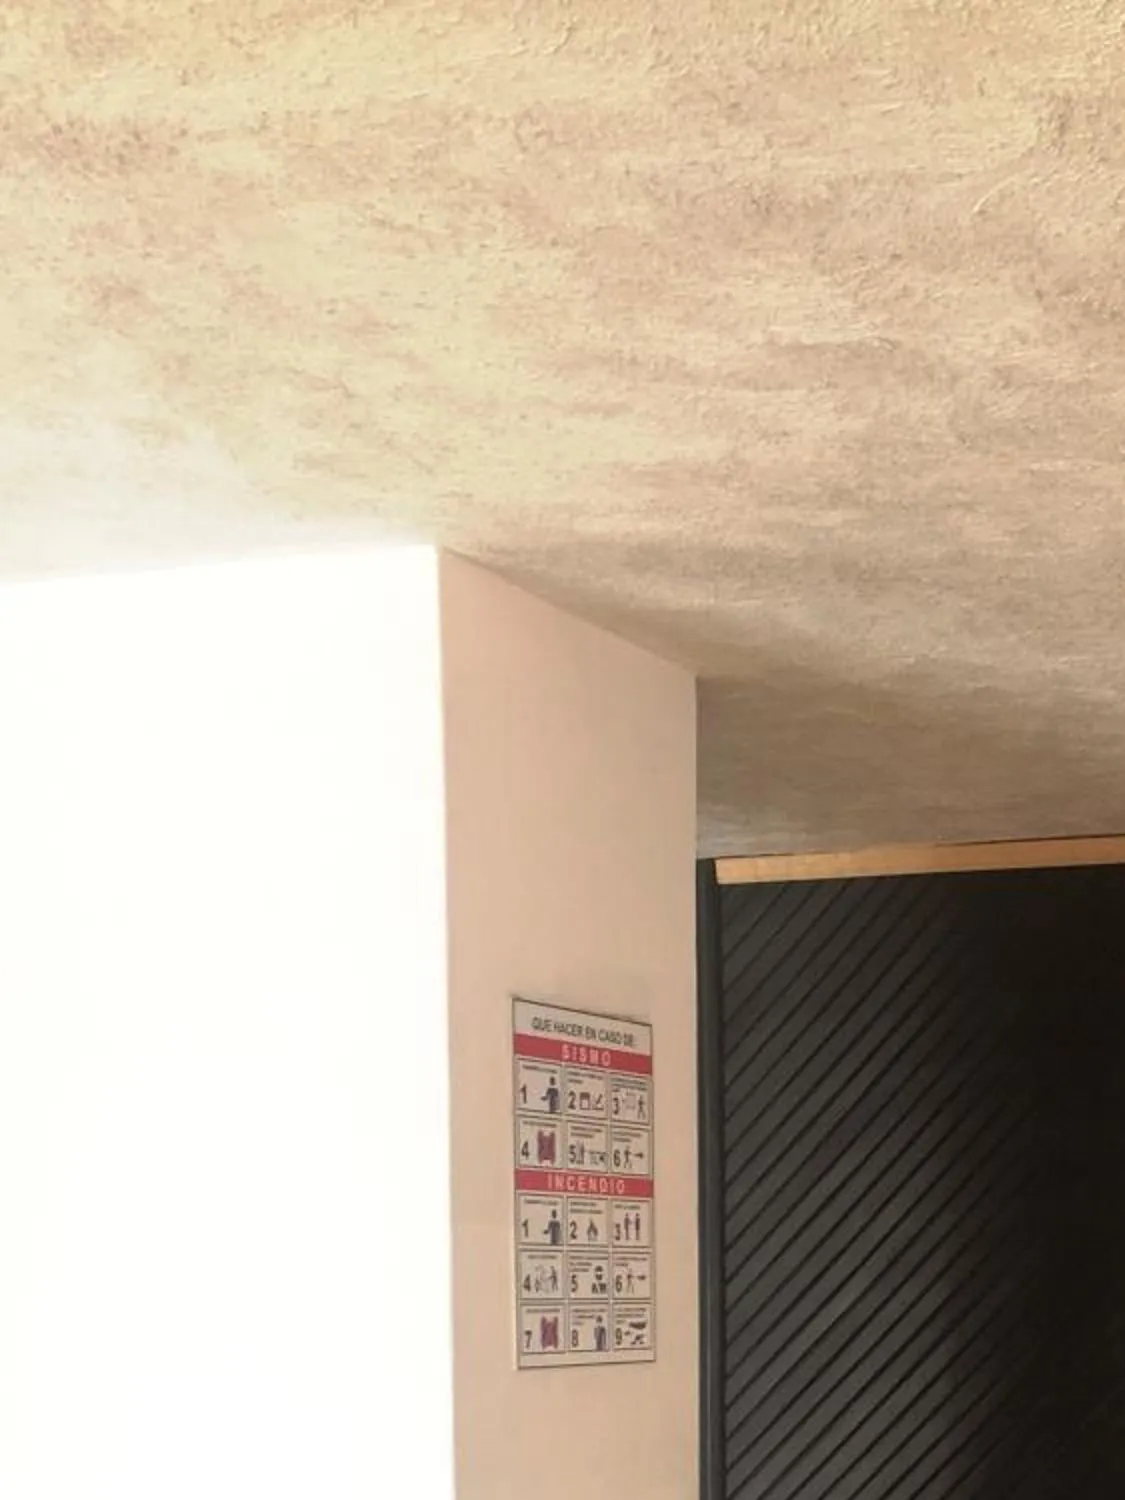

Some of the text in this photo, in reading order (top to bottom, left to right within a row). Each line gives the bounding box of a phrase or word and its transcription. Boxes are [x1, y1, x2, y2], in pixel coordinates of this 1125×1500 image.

[531, 1016, 552, 1032] QUE
[553, 1023, 583, 1038] HACER
[585, 1026, 596, 1040] EN
[598, 1029, 622, 1045] CASO
[561, 1044, 612, 1066] SISMO
[519, 1084, 527, 1104] 1
[567, 1090, 576, 1110] 2
[613, 1097, 620, 1115] 3
[521, 1141, 529, 1160] 4
[569, 1144, 577, 1163] 5
[613, 1149, 621, 1168] 6
[546, 1174, 626, 1194] INCENDIO
[521, 1218, 529, 1238] 1
[569, 1220, 578, 1240] 2
[615, 1223, 621, 1241] 3
[523, 1274, 531, 1292] 4
[571, 1274, 578, 1293] 5
[615, 1275, 623, 1293] 6
[524, 1330, 532, 1349] 7
[571, 1329, 579, 1348] 8
[615, 1327, 623, 1347] 9
